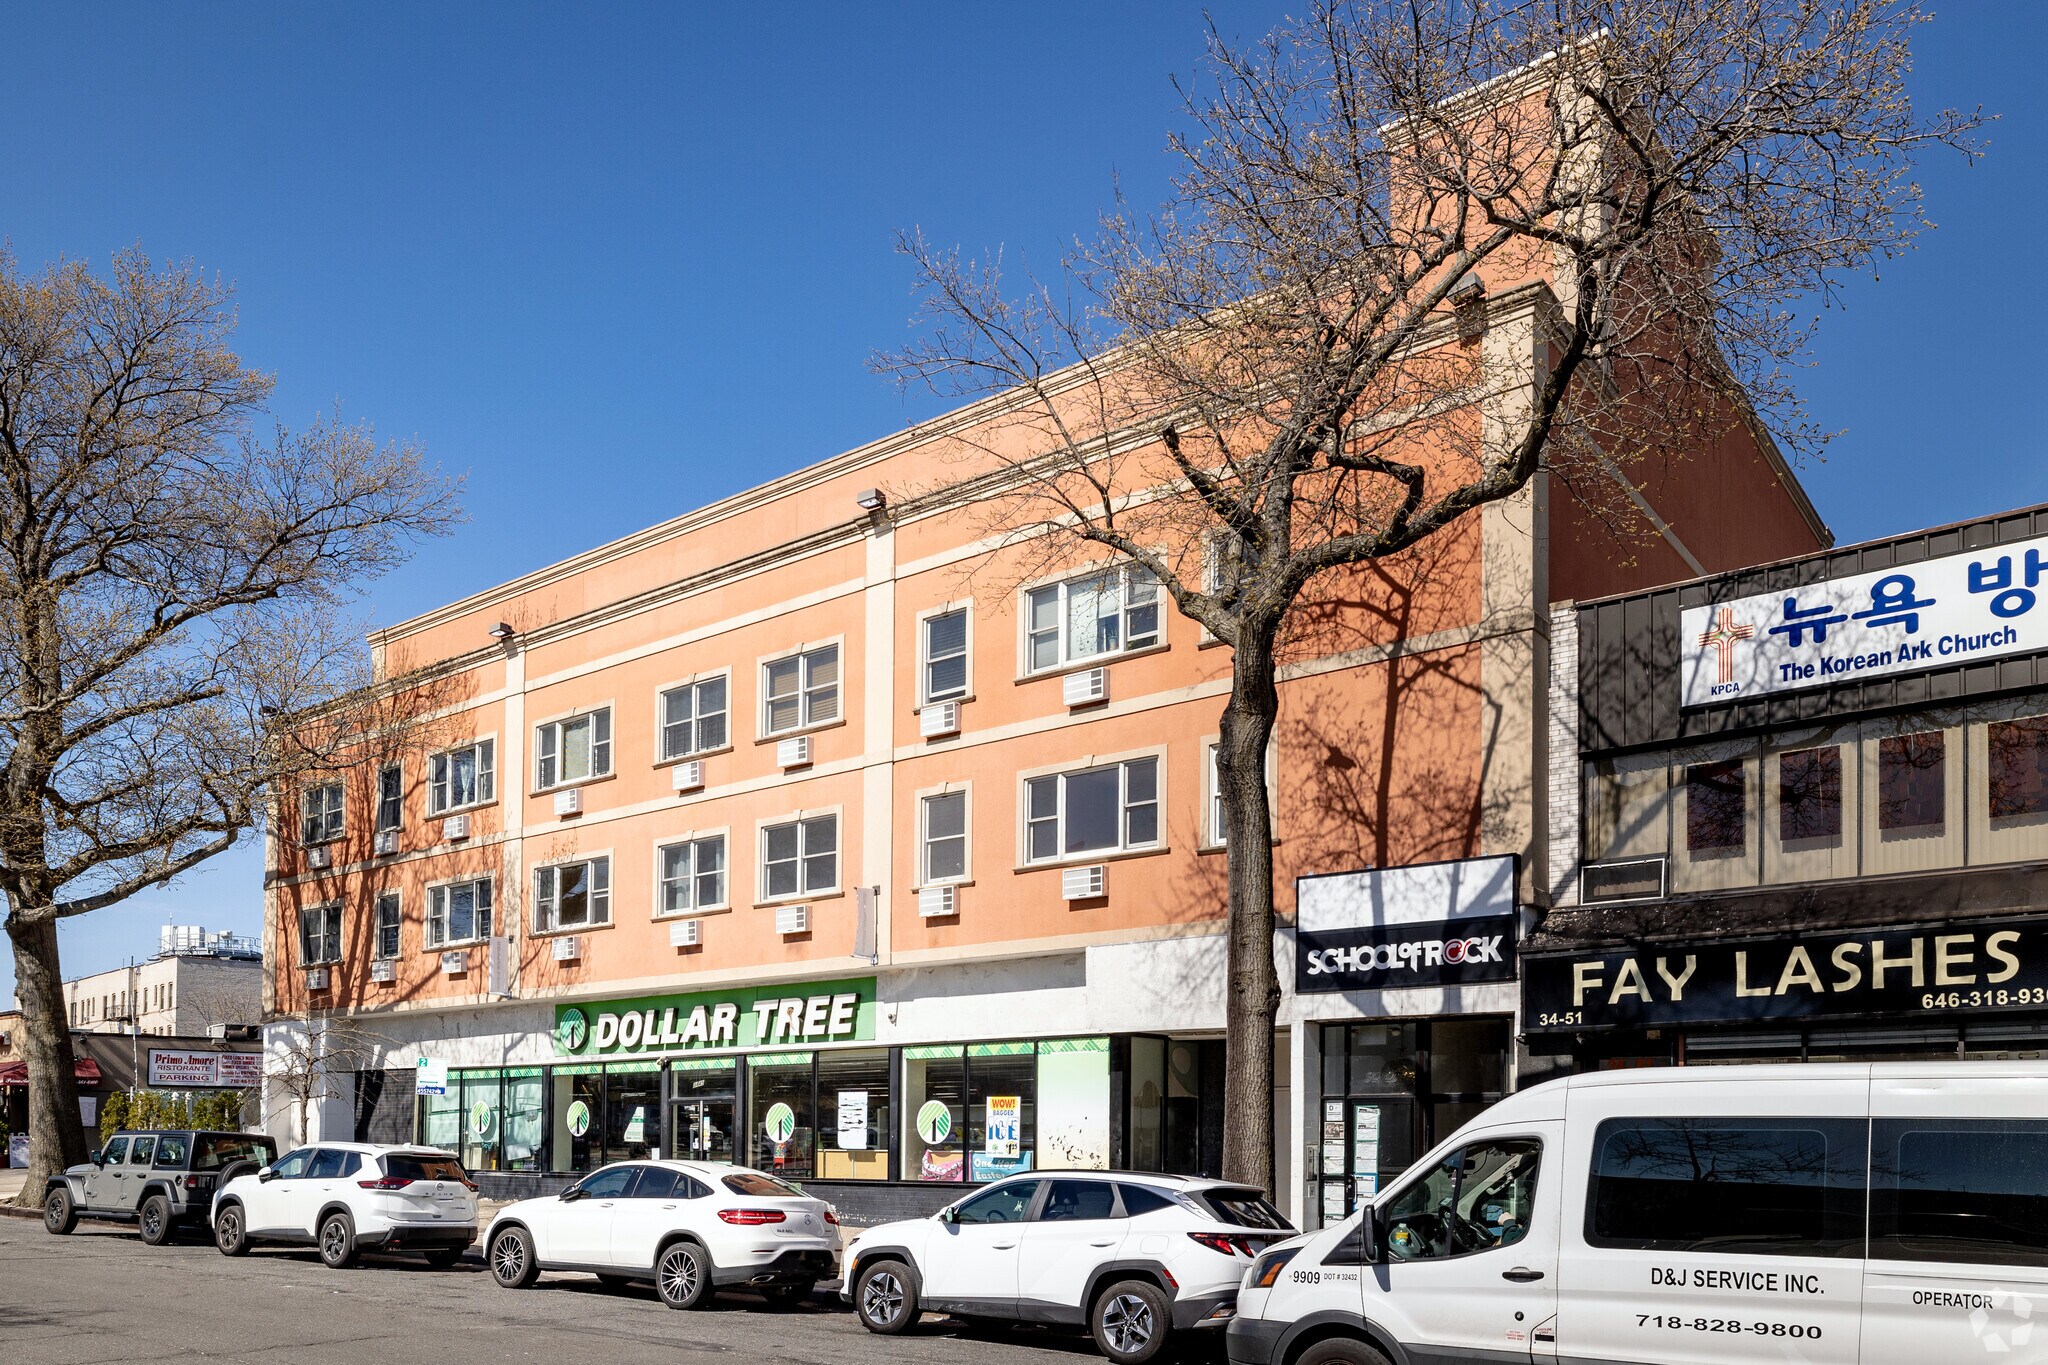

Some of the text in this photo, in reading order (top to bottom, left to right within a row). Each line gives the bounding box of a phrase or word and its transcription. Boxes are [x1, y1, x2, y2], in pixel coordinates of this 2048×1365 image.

[1768, 574, 1937, 647] 뉴욕
[1780, 625, 2018, 682] The Korean Ark Church
[1711, 682, 1741, 696] KPCA
[1573, 930, 2021, 1008] FAY LASHES
[1921, 987, 2048, 1010] 646-318-93
[595, 1003, 741, 1049] DOLLAR
[752, 993, 857, 1039] TREE
[1539, 1011, 1583, 1026] 34-51
[155, 1054, 214, 1065] Primo Amore
[992, 1099, 1016, 1108] WOW!
[988, 1117, 1019, 1140] ICE
[974, 1158, 993, 1168] One
[1293, 1271, 1320, 1284] 9909
[1651, 1268, 1825, 1294] D&J SERVICE INC.
[1913, 1291, 1993, 1309] OPERATOR
[1635, 1314, 1822, 1339] 718-828-9800
